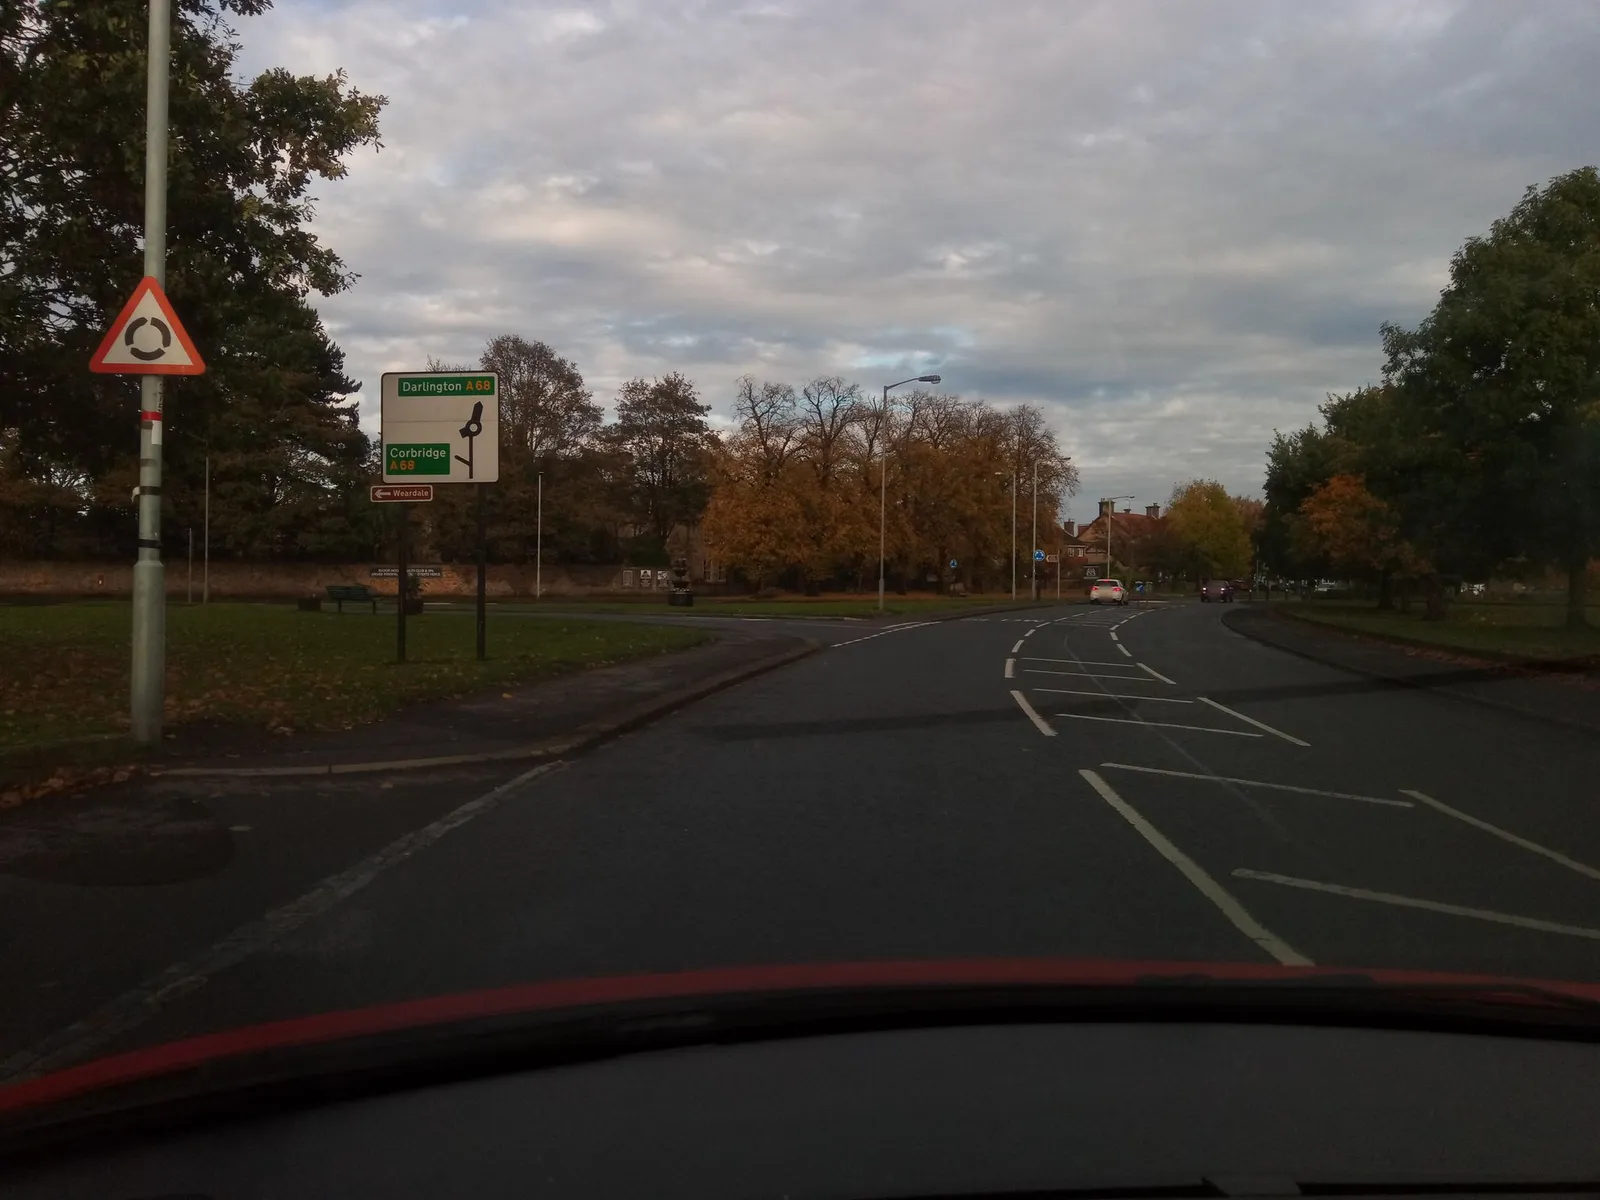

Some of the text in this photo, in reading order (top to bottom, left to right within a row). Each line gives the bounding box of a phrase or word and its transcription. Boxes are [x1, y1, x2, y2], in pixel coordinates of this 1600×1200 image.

[402, 380, 491, 393] Darlington A68
[390, 448, 446, 460] Corbridge
[390, 460, 415, 470] A68
[393, 489, 429, 497] Weardale
